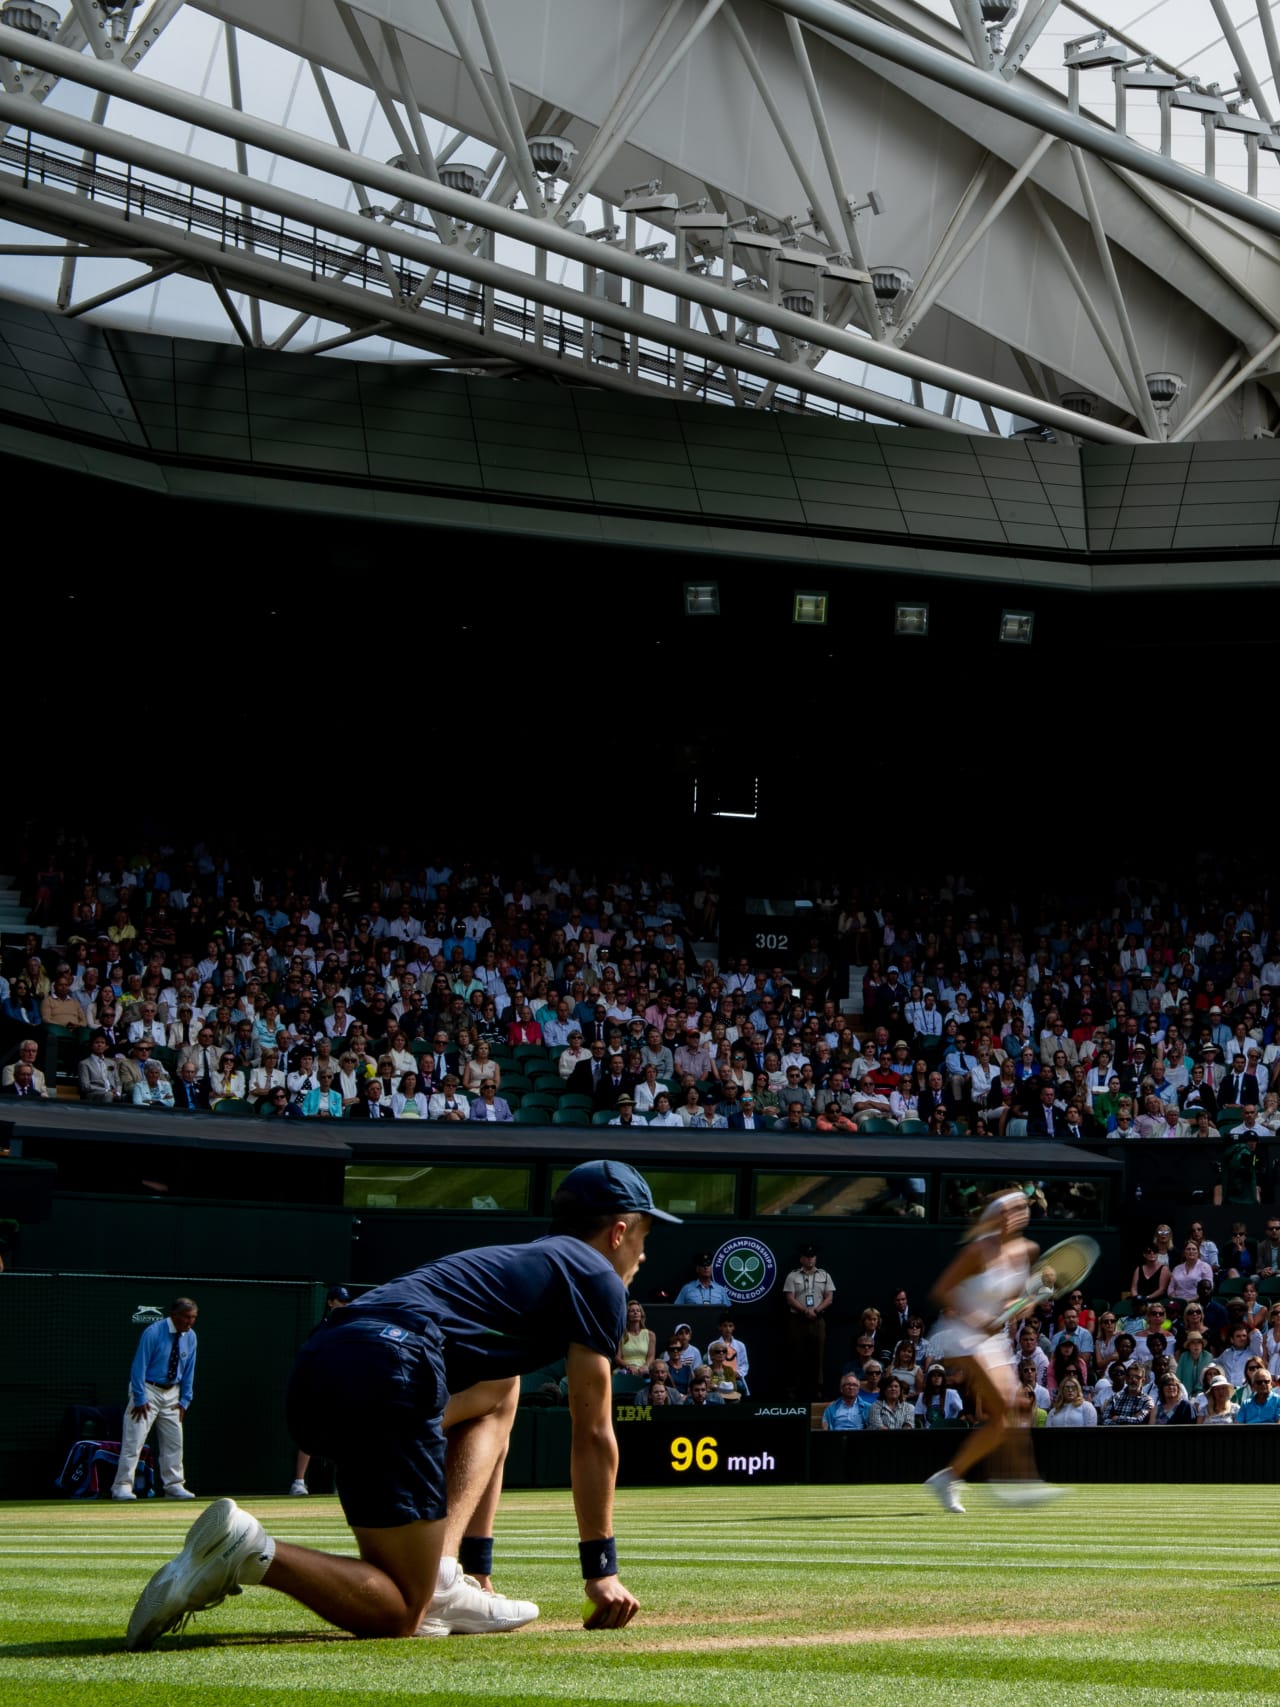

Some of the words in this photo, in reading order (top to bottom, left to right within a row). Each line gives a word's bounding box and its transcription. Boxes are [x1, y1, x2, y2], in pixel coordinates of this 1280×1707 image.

[755, 933, 788, 950] 302
[715, 1252, 725, 1268] THE
[723, 1240, 773, 1269] CHAMPIONSHIPS
[724, 1284, 766, 1300] WIMBLEDON
[616, 1405, 652, 1421] IBM
[754, 1408, 807, 1416] JAGUAR
[670, 1436, 719, 1471] 96
[727, 1452, 775, 1475] mph
